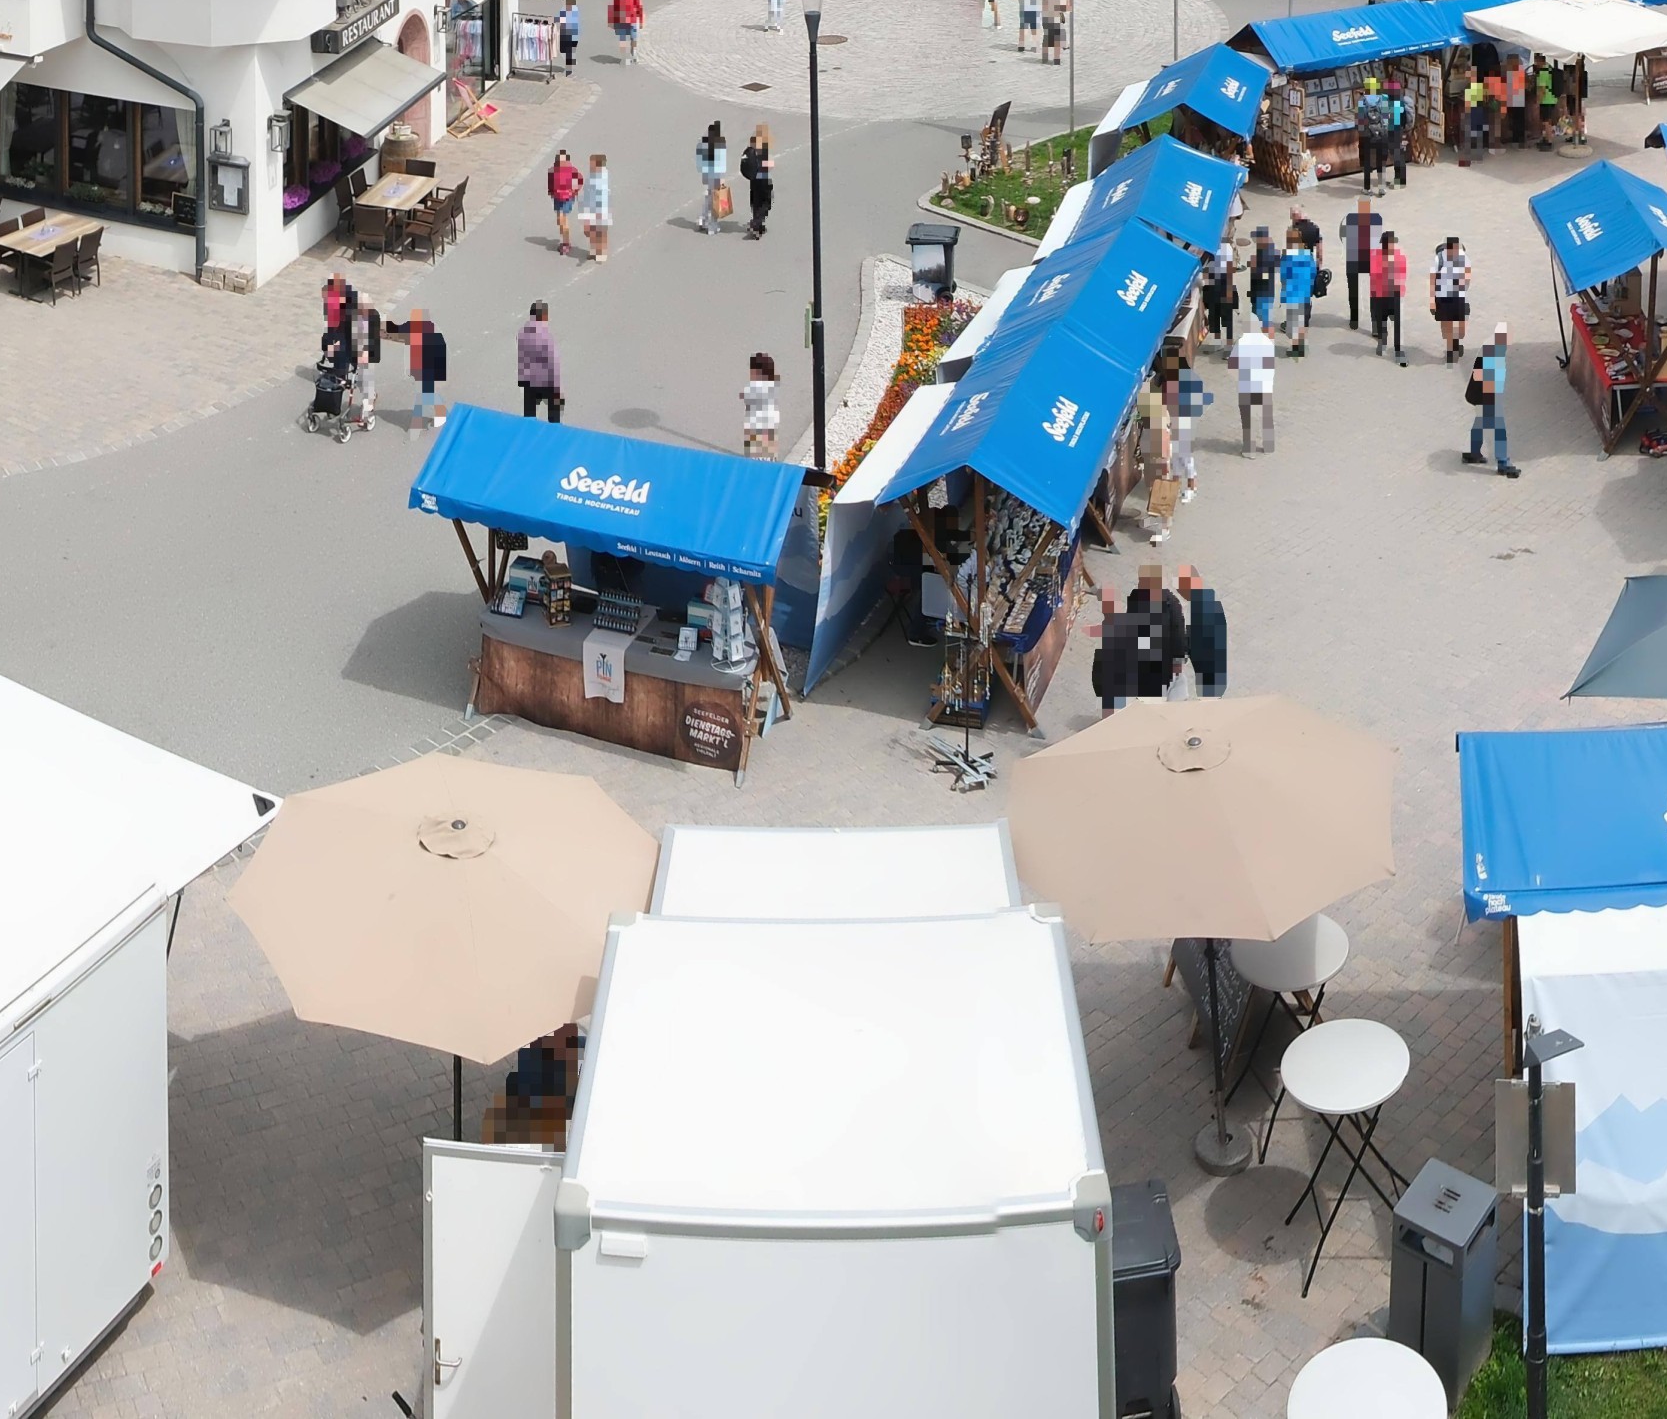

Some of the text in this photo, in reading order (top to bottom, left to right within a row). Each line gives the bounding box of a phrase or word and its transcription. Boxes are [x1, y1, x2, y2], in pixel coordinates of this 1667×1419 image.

[1332, 24, 1376, 42] Seefeld
[1116, 269, 1148, 307] Seefeld
[1042, 395, 1079, 442] Seefeld
[560, 466, 651, 505] Seefeld
[556, 491, 641, 516] TIROLS HOCHPLATEAU
[685, 715, 736, 739] DIENSTAGS-
